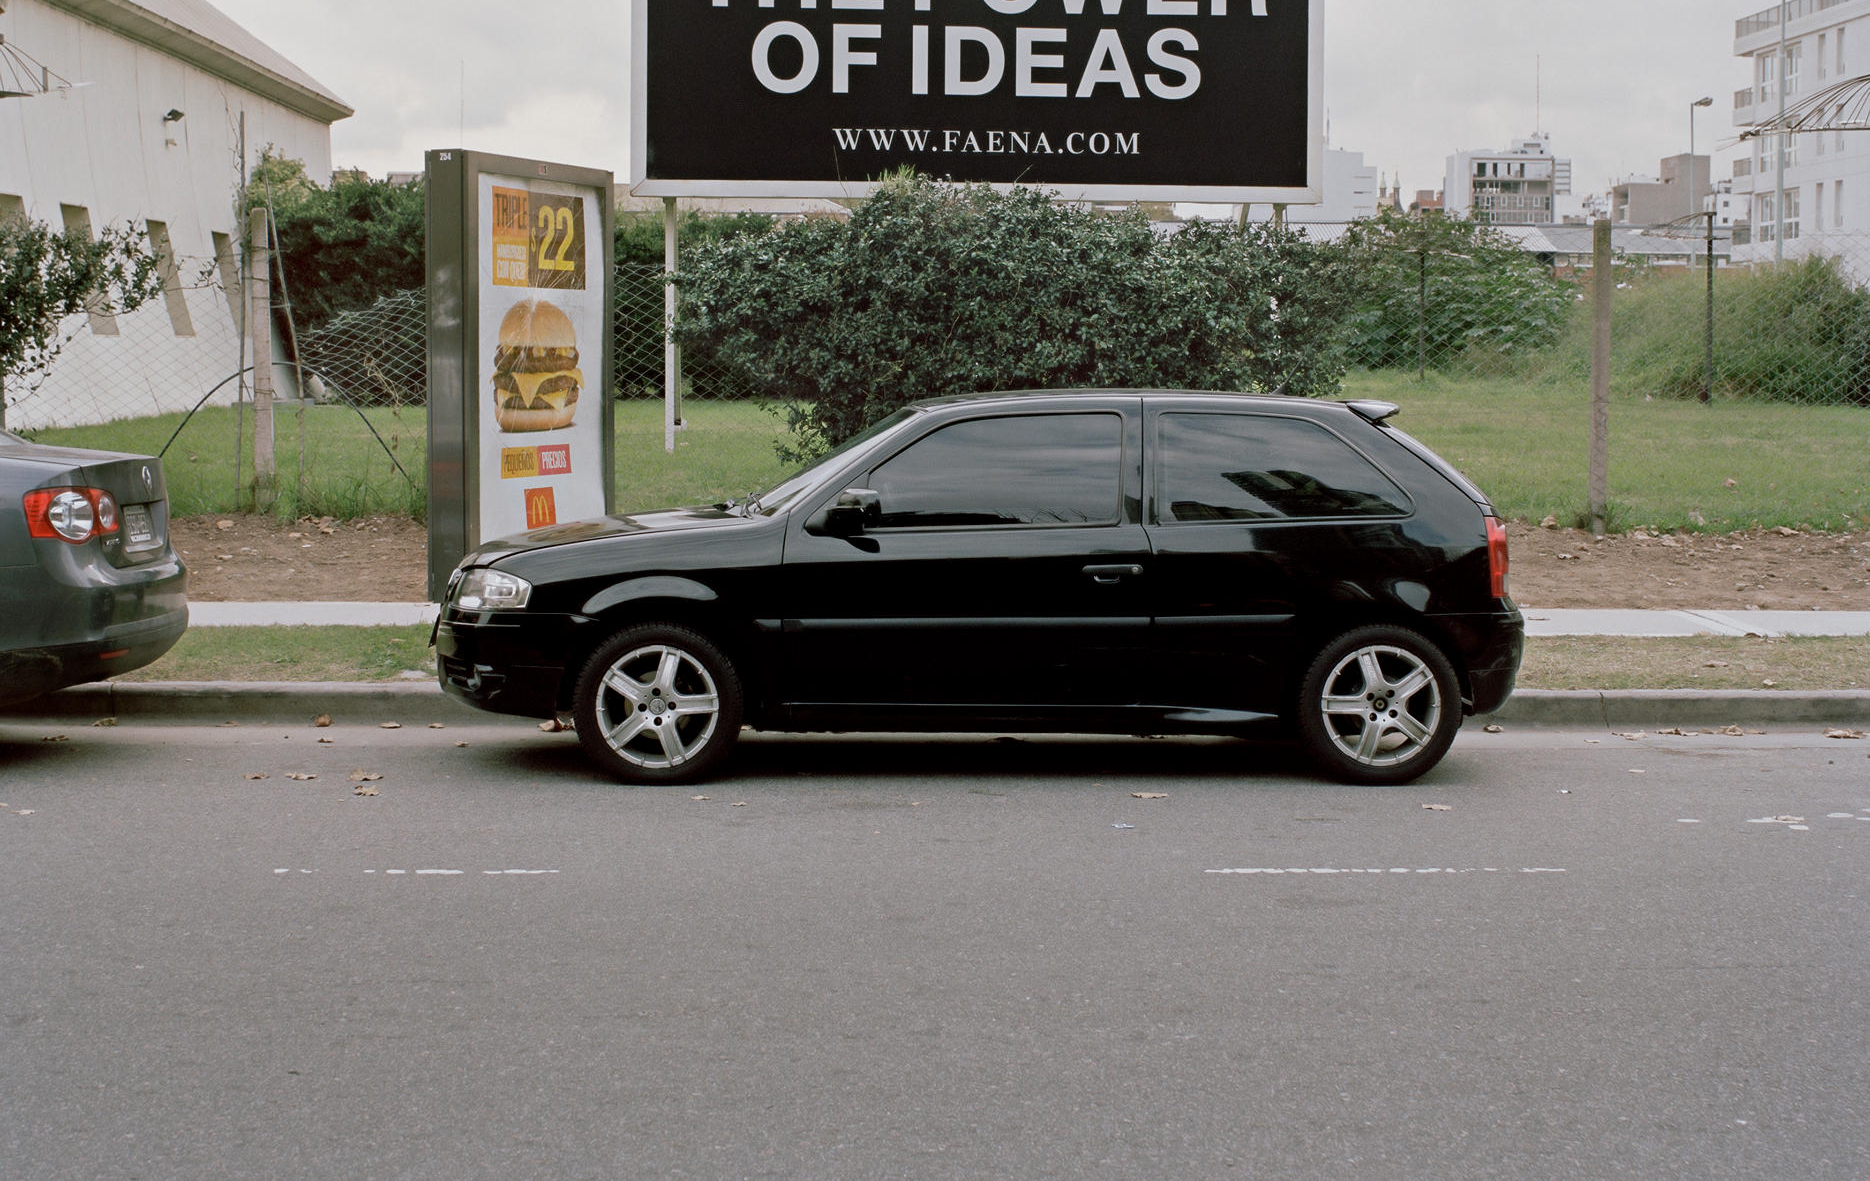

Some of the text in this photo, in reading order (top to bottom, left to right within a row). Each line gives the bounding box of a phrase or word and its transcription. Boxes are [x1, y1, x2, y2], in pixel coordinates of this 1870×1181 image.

[751, 20, 1202, 100] OF IDEAS
[832, 127, 1141, 155] WWW.FAENA.COM
[495, 193, 528, 230] TRIPLE
[542, 450, 567, 470] PRECIOS
